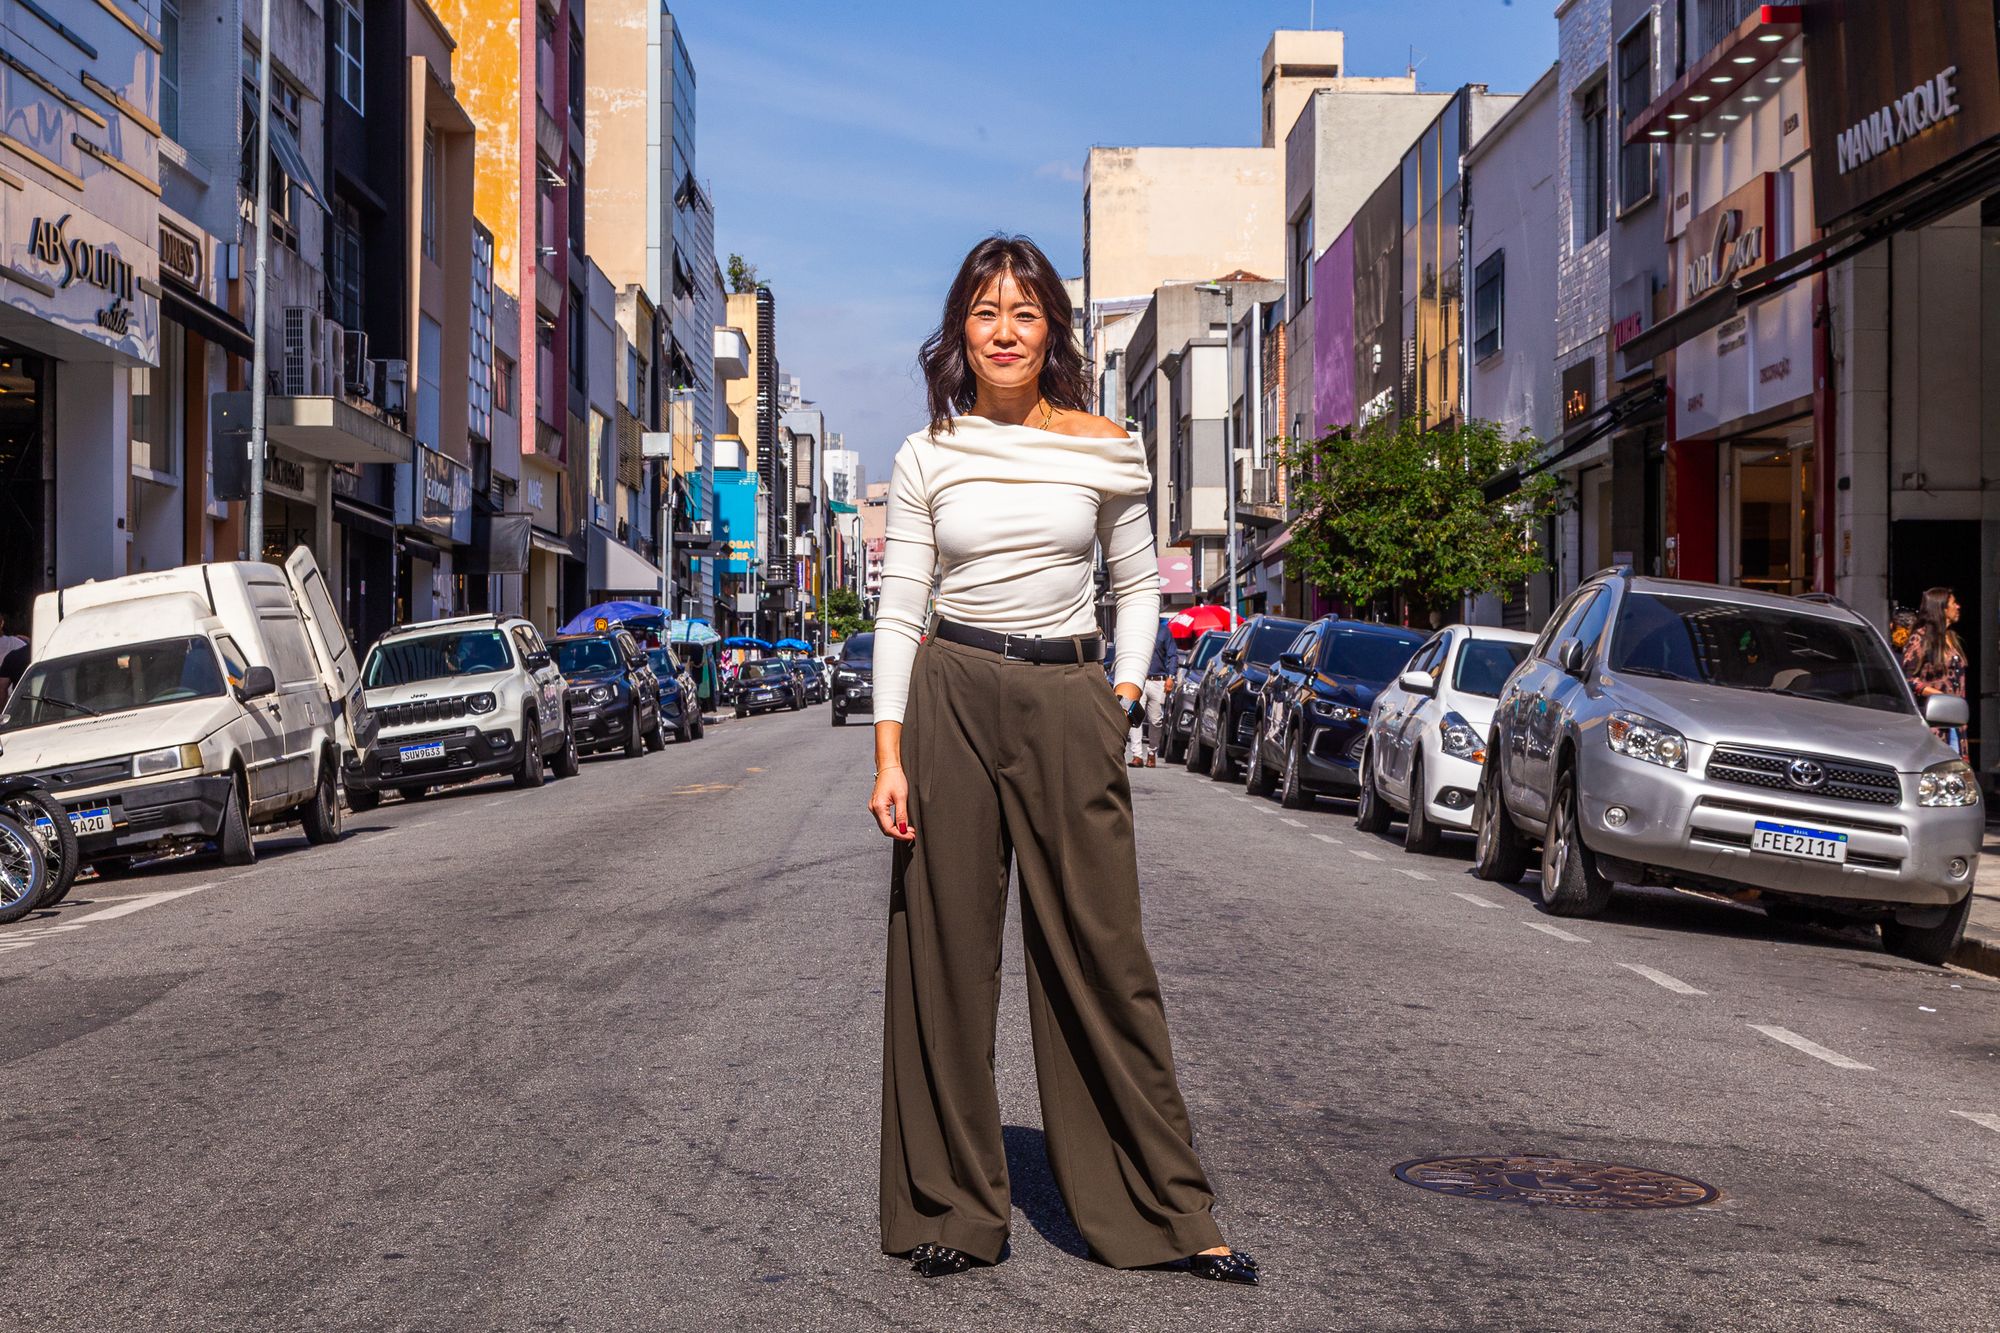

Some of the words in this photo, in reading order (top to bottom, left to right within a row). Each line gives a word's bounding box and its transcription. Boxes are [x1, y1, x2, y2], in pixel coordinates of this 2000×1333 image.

[1837, 106, 1896, 175] MANIA
[1894, 65, 1960, 144] XIQUE
[159, 228, 195, 278] DRESS
[1687, 250, 1713, 298] PORT
[45, 816, 104, 838] D6A20
[1762, 832, 1836, 858] FEE2I11
